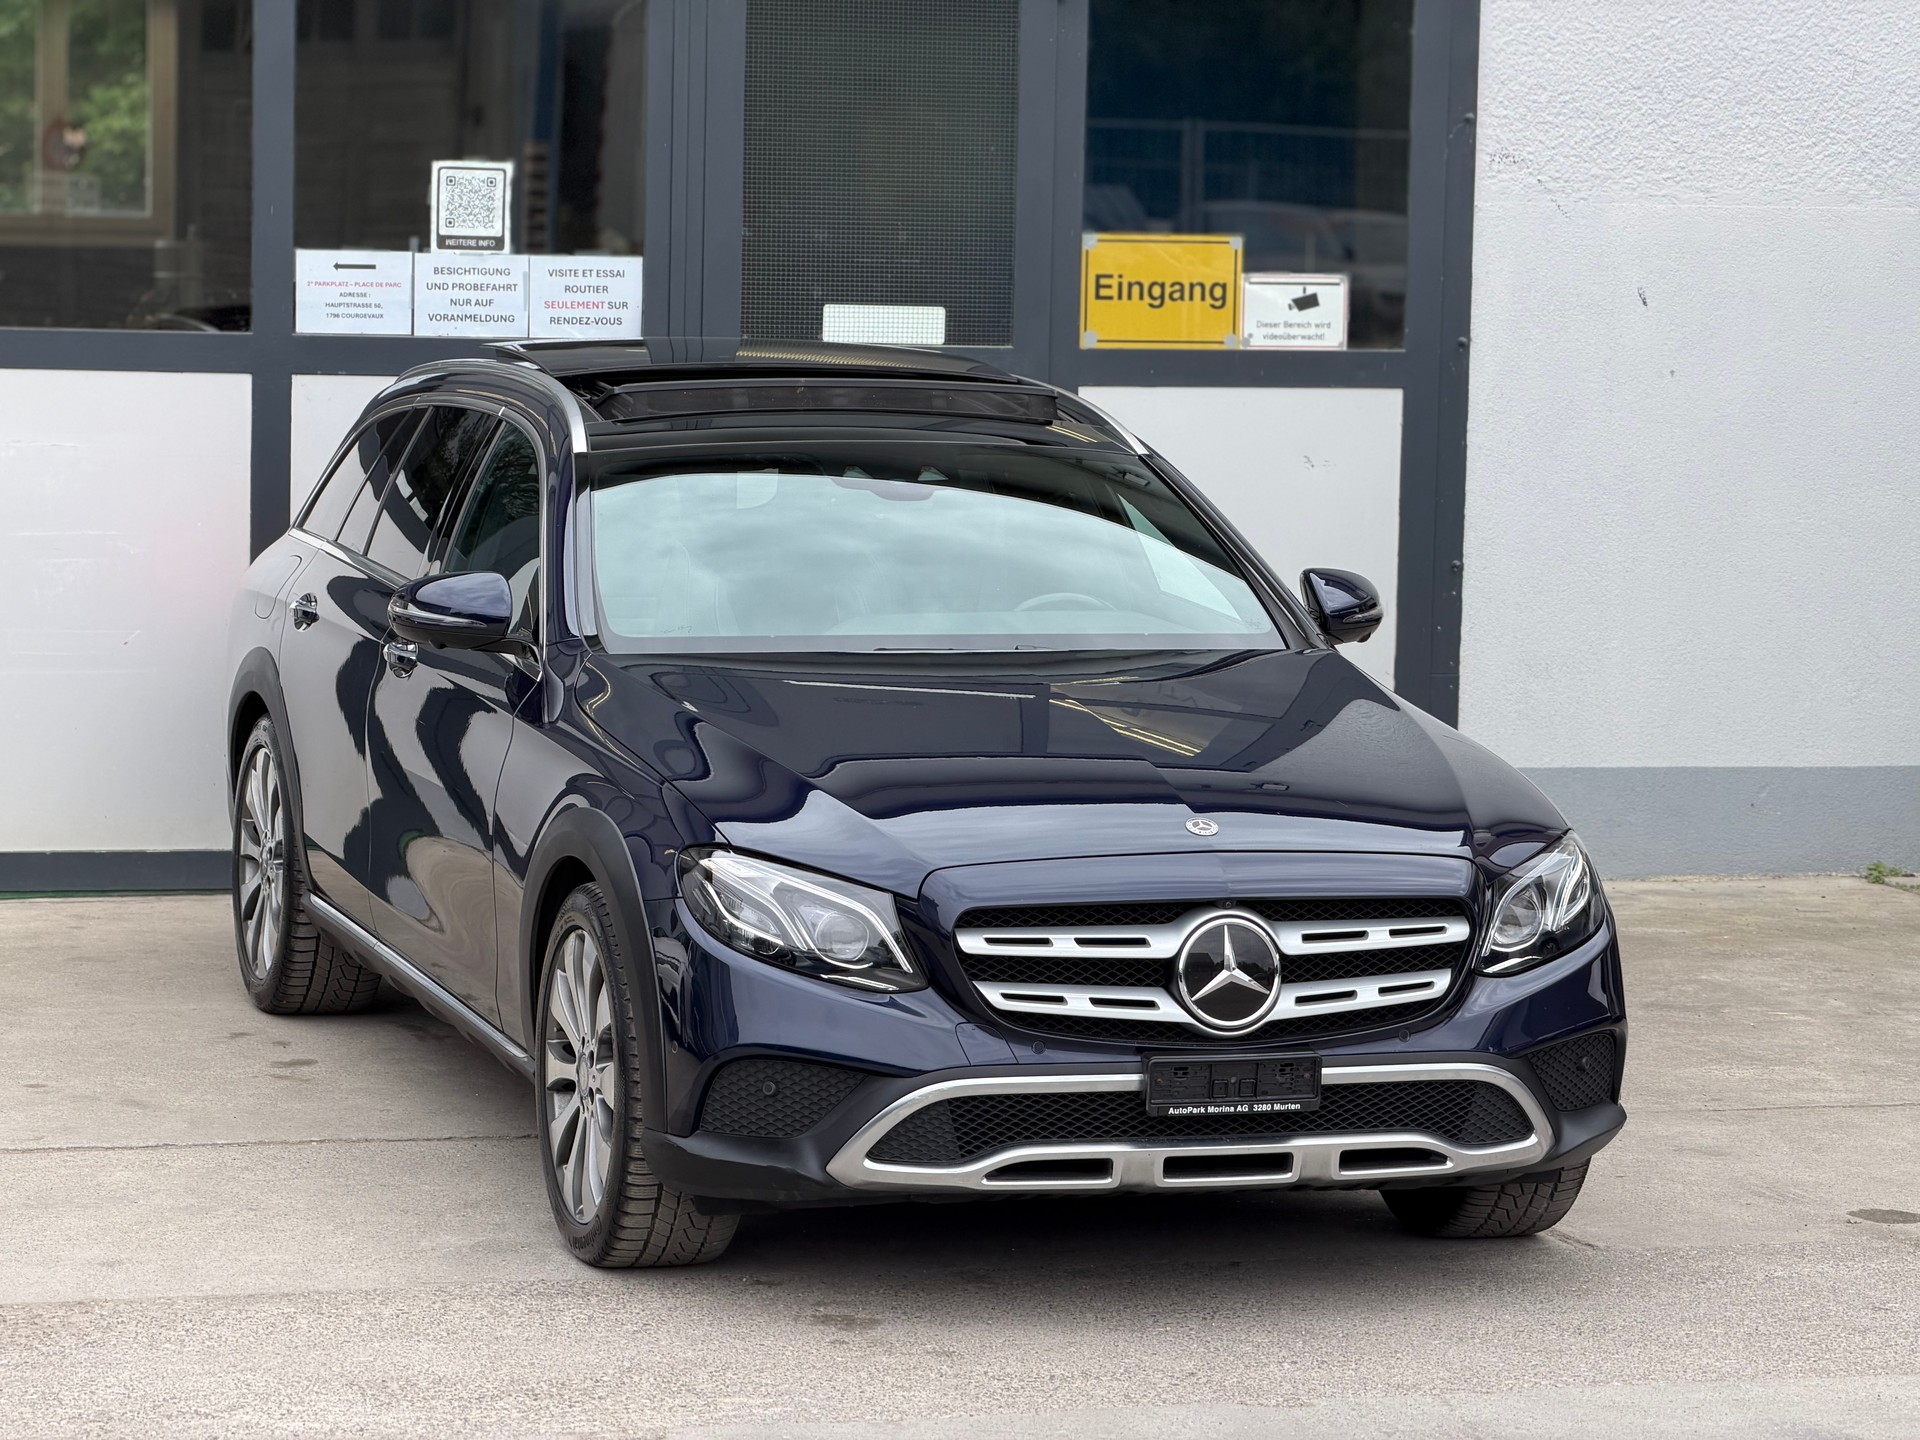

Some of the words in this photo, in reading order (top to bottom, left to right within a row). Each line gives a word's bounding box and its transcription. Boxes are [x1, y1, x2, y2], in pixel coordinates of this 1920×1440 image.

[478, 239, 496, 247] INFO
[433, 266, 511, 276] BESICHTIGUNG
[548, 268, 579, 278] VISITE
[582, 269, 594, 278] ET
[596, 269, 625, 278] ESSAI
[426, 282, 449, 291] UND
[451, 282, 518, 292] PROBEFAHRT
[564, 285, 609, 294] ROUTIER
[1094, 273, 1228, 310] Eingang
[450, 298, 472, 307] NUR
[474, 298, 494, 307] AUF
[544, 301, 605, 310] SEULEMENT
[607, 301, 628, 310] SUR
[428, 313, 515, 323] VORANMELDUNG
[549, 316, 623, 326] RENDEZ-VOUS
[1256, 320, 1281, 329] Dieser
[1283, 320, 1312, 329] Bereich
[1314, 321, 1331, 329] wird
[1262, 332, 1325, 341] videoüberwacht!
[1168, 1106, 1206, 1115] AutoPark
[1207, 1105, 1235, 1113] Morina
[1236, 1104, 1249, 1112] AG
[1253, 1103, 1272, 1112] 3280
[1273, 1102, 1301, 1111] Murten
